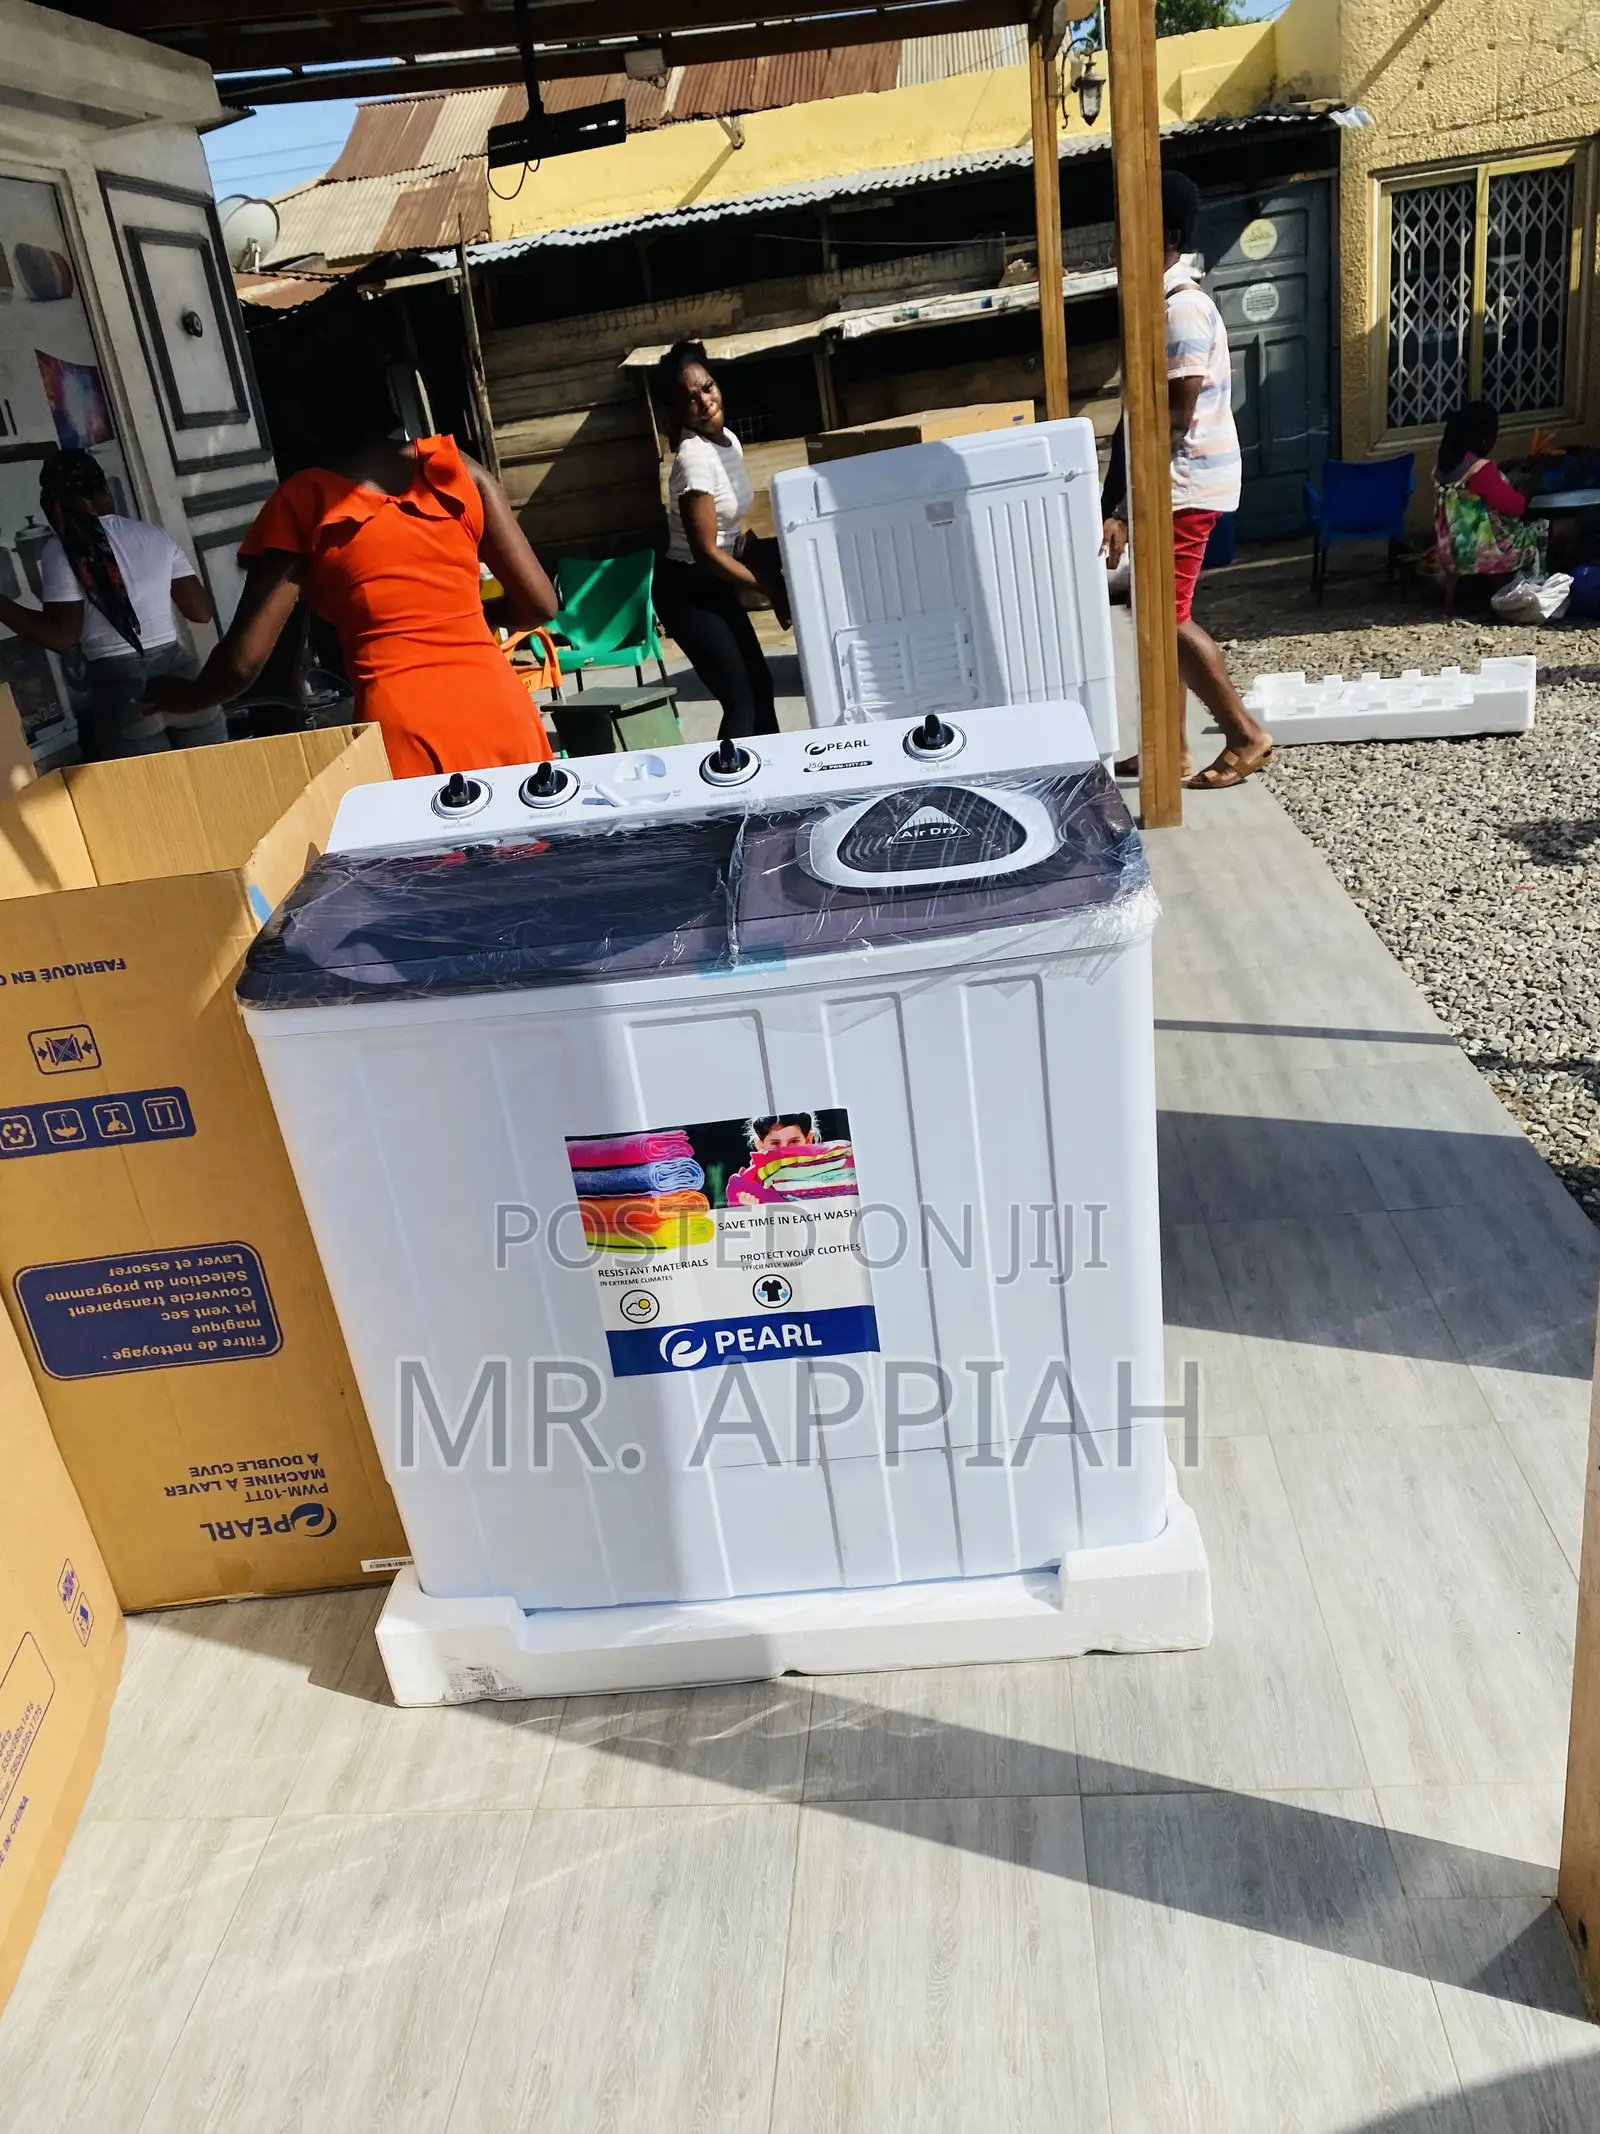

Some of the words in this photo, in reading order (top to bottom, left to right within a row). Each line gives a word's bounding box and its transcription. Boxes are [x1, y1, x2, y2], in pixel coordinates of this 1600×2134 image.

[827, 739, 870, 751] PEARL
[901, 829, 925, 839] Air
[930, 826, 959, 836] Dry
[11, 970, 37, 985] EN
[39, 957, 127, 983] FABRIQUÉ
[718, 1219, 746, 1231] SAVE
[748, 1216, 775, 1228] TIME
[778, 1215, 790, 1225] IN
[792, 1212, 822, 1224] EACH
[824, 1208, 858, 1220] WASH
[197, 1253, 244, 1266] Laver
[740, 1250, 784, 1263] PROTECT
[786, 1247, 815, 1258] YOUR
[817, 1242, 861, 1256] CLOTHES
[109, 1261, 170, 1277] essorer
[175, 1259, 192, 1271] et
[598, 1265, 650, 1278] RESISTANT
[652, 1258, 709, 1273] MATERIALS
[742, 1261, 781, 1272] EFFICIENTLY
[783, 1260, 804, 1268] WASH
[144, 1279, 164, 1291] du
[169, 1270, 248, 1286] Sélection
[609, 1278, 639, 1287] EXTREME
[640, 1275, 673, 1284] CLIMATES
[45, 1280, 140, 1302] programme
[170, 1286, 252, 1305] Couvercle
[68, 1296, 166, 1318] transparent
[193, 1306, 231, 1319] vent
[234, 1300, 258, 1314] jet
[161, 1310, 190, 1321] sec
[192, 1319, 262, 1334] magique
[198, 1340, 217, 1351] de
[222, 1335, 267, 1348] Filtre
[714, 1323, 823, 1355] PEARL
[112, 1342, 193, 1360] nettoyage
[237, 1454, 304, 1473] DOUBLE
[307, 1453, 319, 1466] À
[188, 1462, 234, 1478] CUVE
[244, 1467, 327, 1488] MACHINE
[164, 1480, 222, 1497] LAVER
[226, 1478, 238, 1492] À
[244, 1482, 329, 1503] PWM-10TT
[199, 1513, 292, 1542] PEARL
[3, 1833, 12, 1852] IN
[10, 1795, 29, 1835] CHINA
